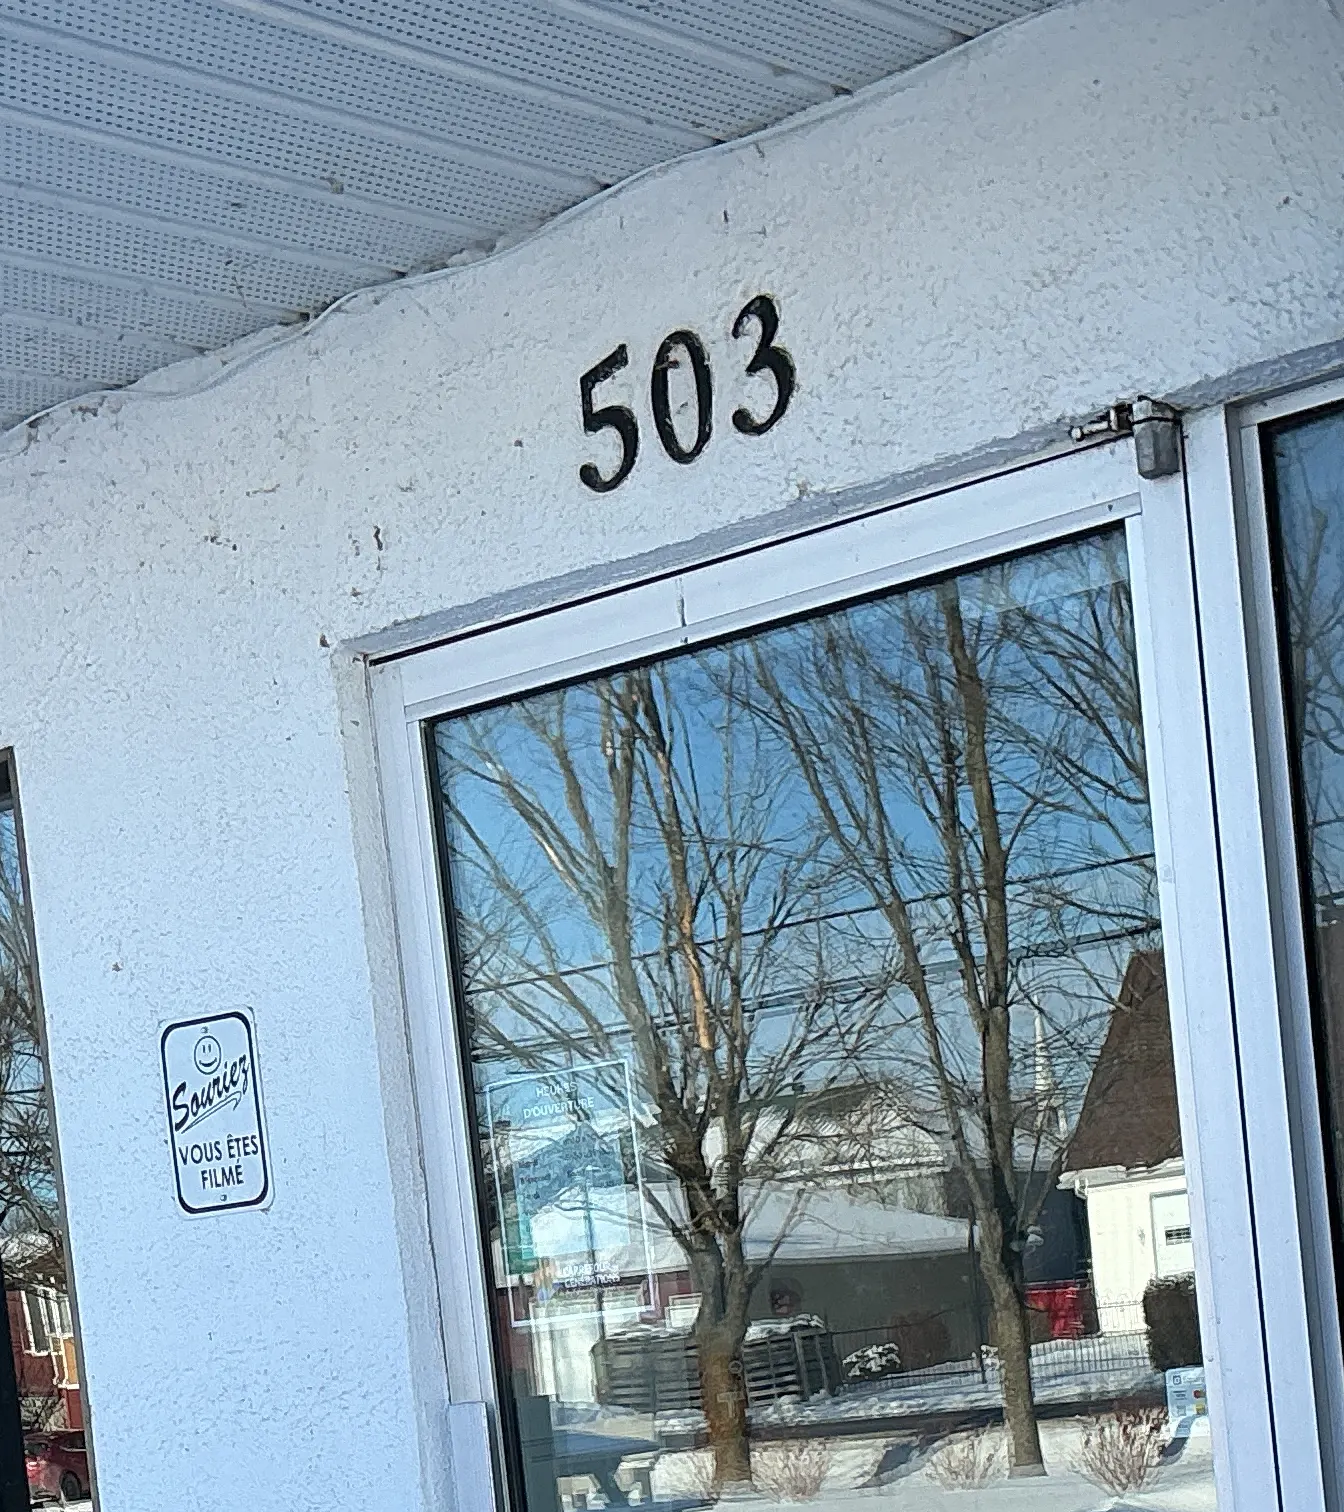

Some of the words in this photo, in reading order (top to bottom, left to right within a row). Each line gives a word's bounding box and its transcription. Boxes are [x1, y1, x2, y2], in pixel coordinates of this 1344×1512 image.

[579, 294, 797, 493] 503
[172, 1053, 251, 1133] Souriez
[536, 1081, 578, 1098] HEURES
[522, 1096, 595, 1119] D'OUVERTURE
[178, 1140, 223, 1166] VOUS
[226, 1133, 259, 1160] ÊTES
[200, 1158, 244, 1190] FILMÉ
